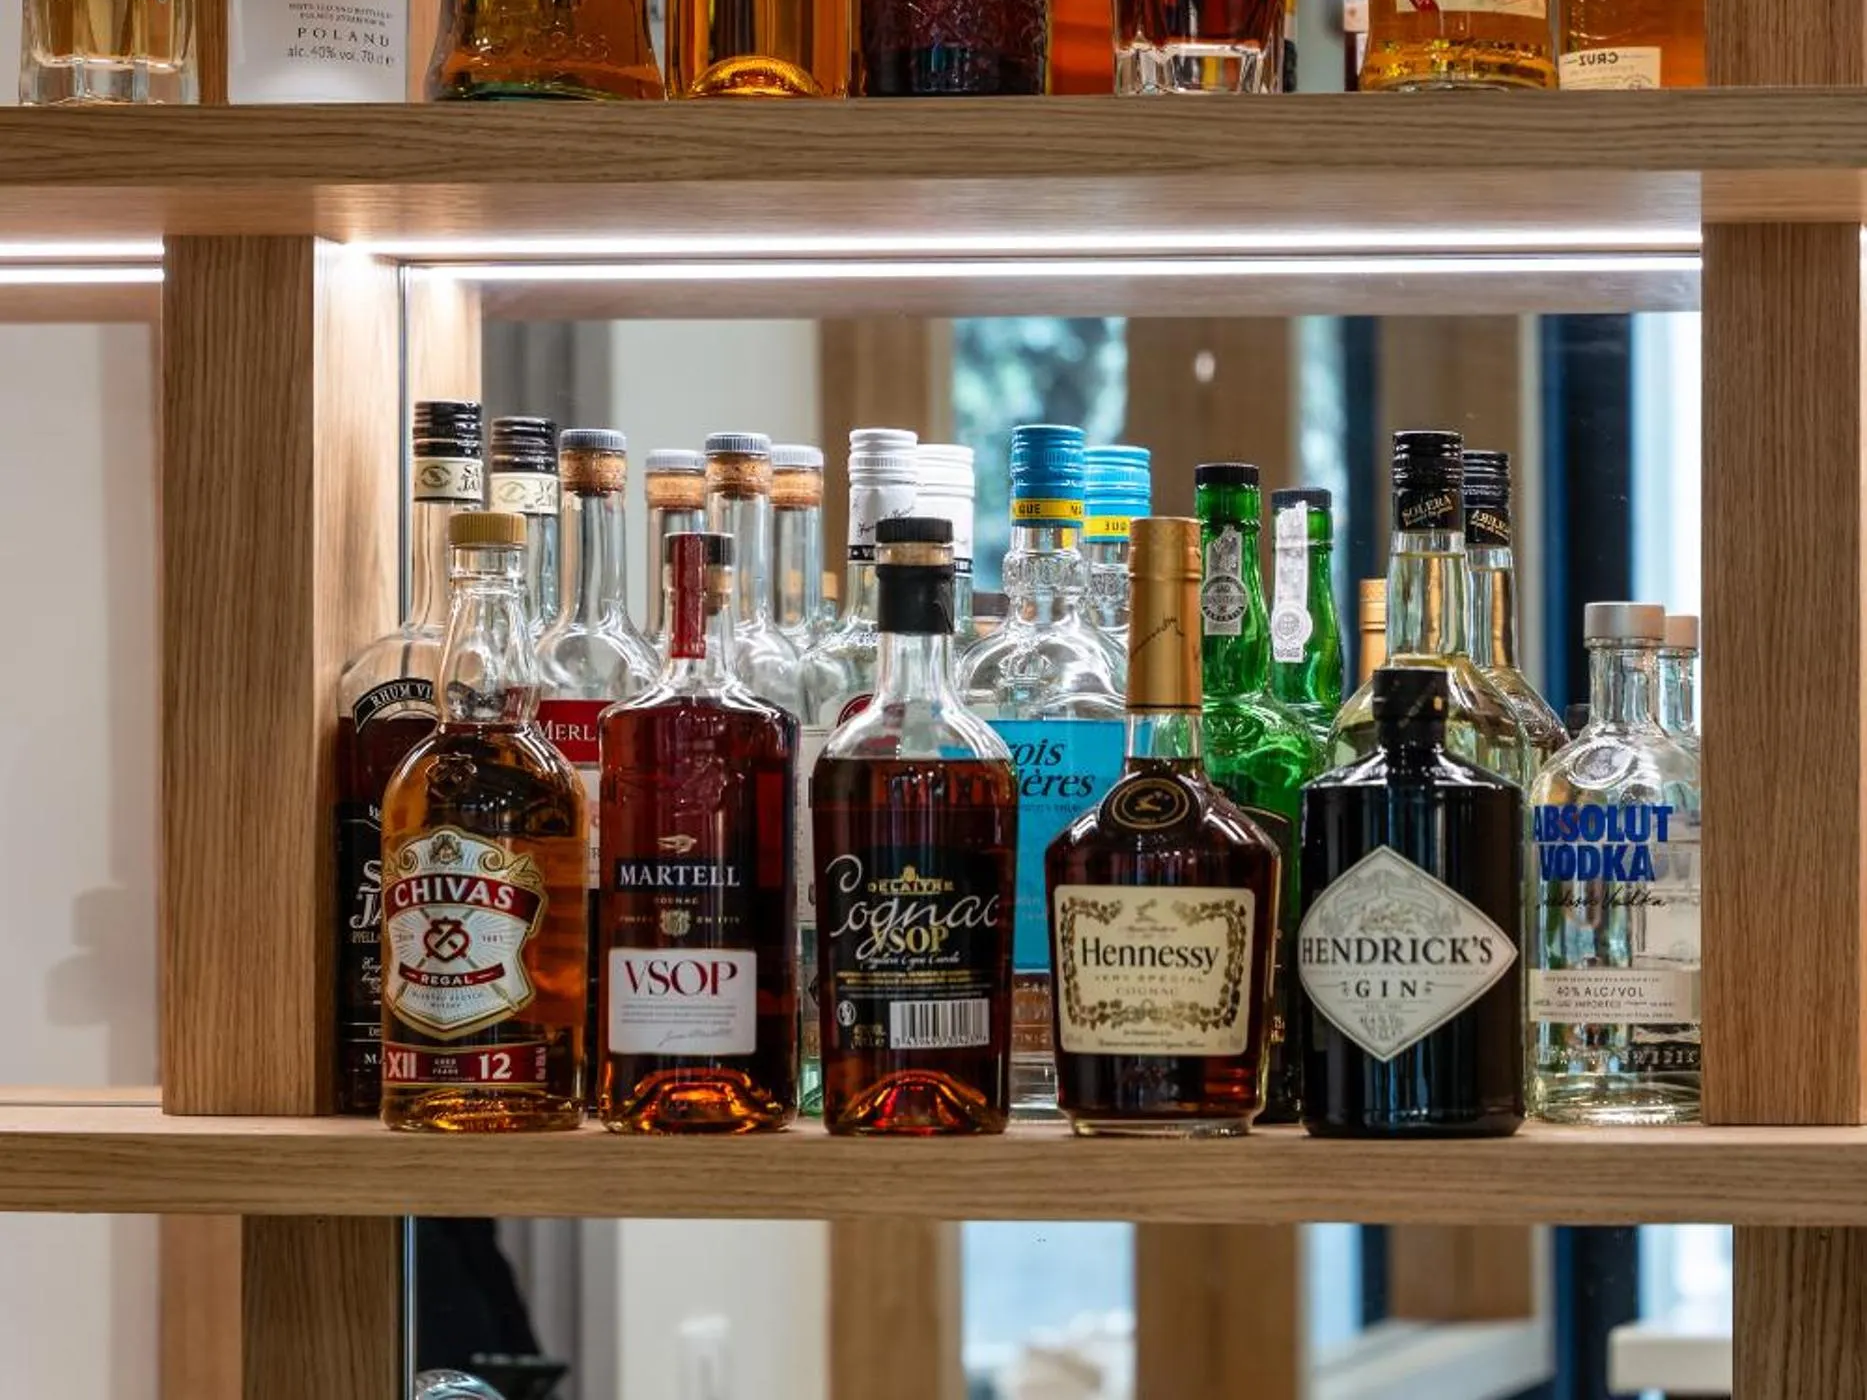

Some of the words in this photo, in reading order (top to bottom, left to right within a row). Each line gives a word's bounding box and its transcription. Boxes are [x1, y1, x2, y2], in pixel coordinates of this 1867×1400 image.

[297, 26, 390, 48] POLAND
[371, 683, 412, 708] RHUM
[535, 719, 597, 742] MERL
[1009, 738, 1066, 767] ois
[1018, 767, 1096, 798] ères
[1533, 802, 1674, 843] ABSOLUT
[619, 864, 741, 888] MARTELL
[1539, 843, 1656, 882] VODKA
[393, 875, 517, 912] CHIVAS
[1081, 936, 1220, 976] Hennessy
[1301, 935, 1494, 966] HENDRICK'S
[419, 974, 474, 986] REGAL
[624, 959, 738, 997] VSOP
[1355, 979, 1418, 998] GIN
[387, 1051, 418, 1080] XII
[477, 1052, 513, 1080] 12
